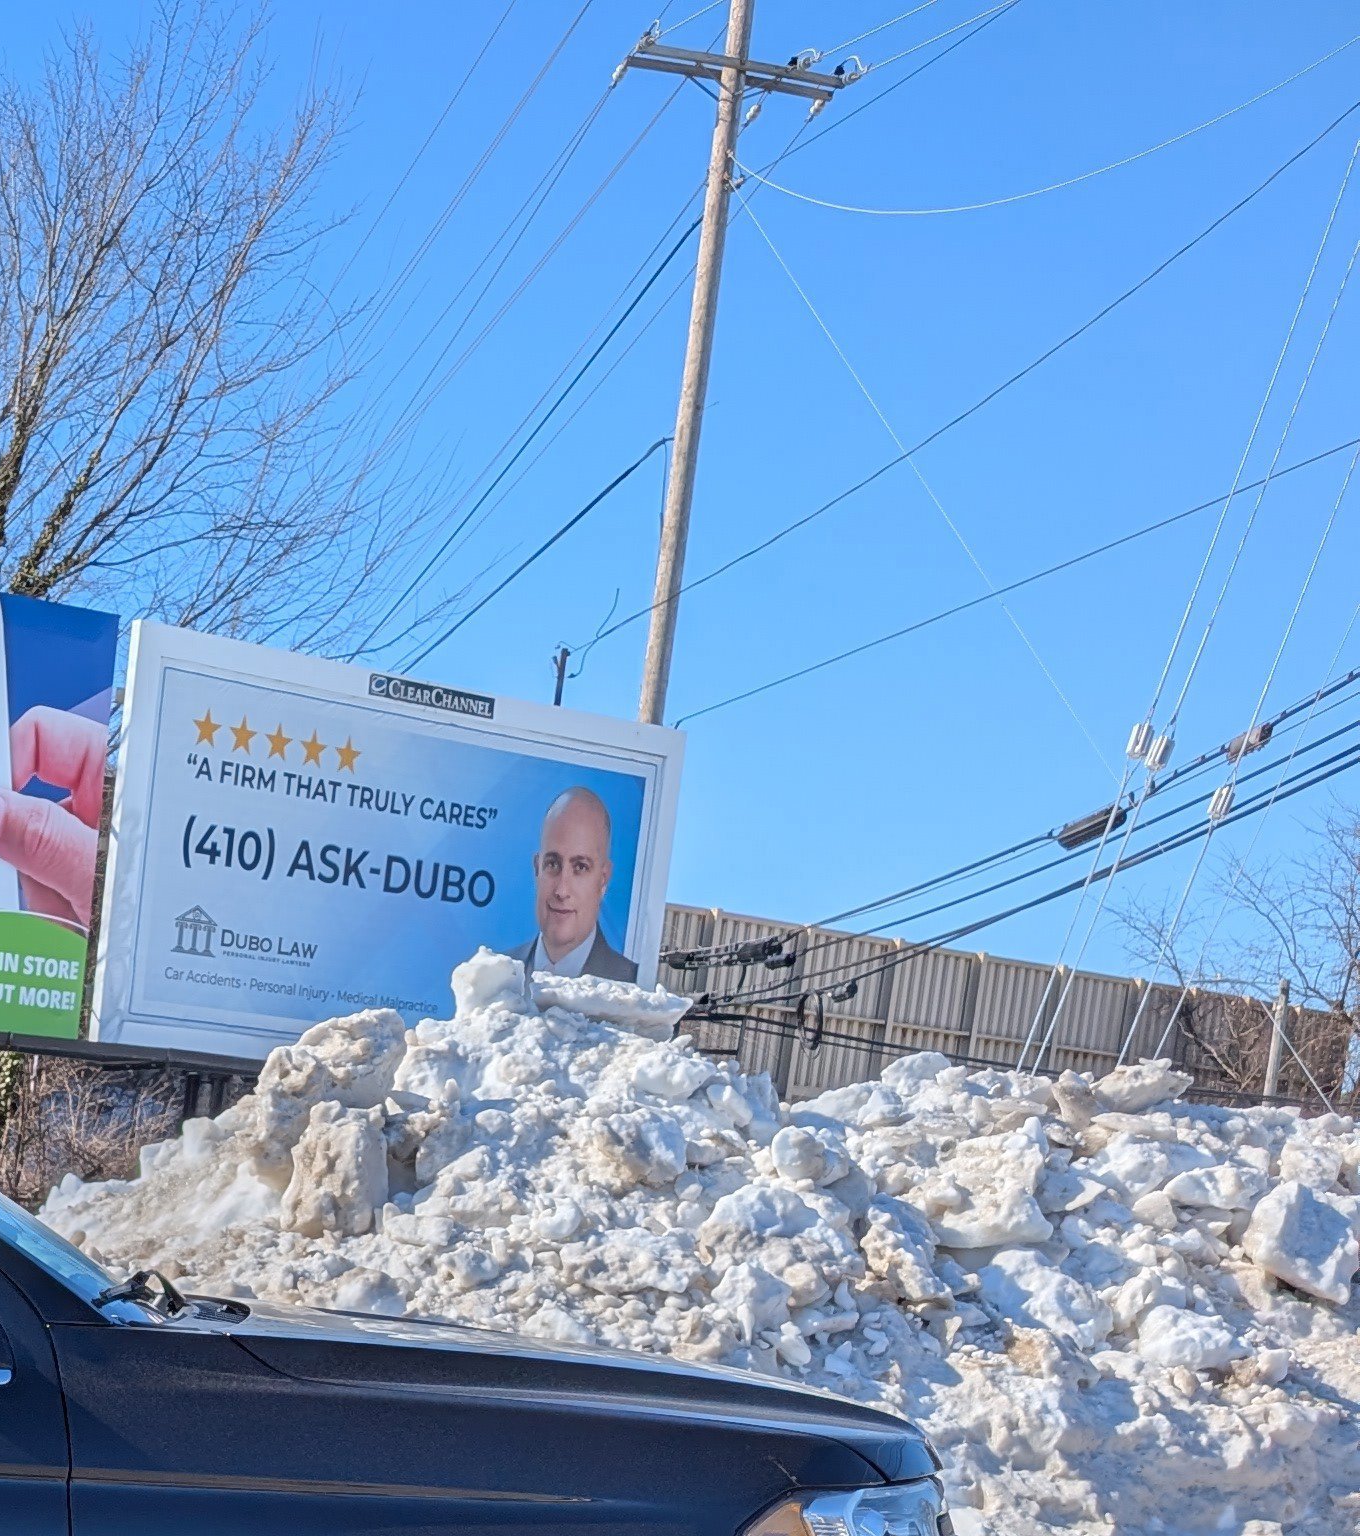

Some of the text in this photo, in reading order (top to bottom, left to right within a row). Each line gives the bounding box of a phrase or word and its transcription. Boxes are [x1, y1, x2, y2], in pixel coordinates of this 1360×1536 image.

[218, 760, 277, 793] FIRM
[282, 771, 342, 804] THAT
[346, 783, 416, 817] TRULY
[182, 814, 496, 909] (410) ASK-DUBO
[220, 928, 319, 960] DUBO LAW
[22, 955, 80, 981] STORE
[18, 986, 77, 1012] MORE!
[164, 966, 439, 1014] Car Accidents Personal Injury Medical Malpractice
